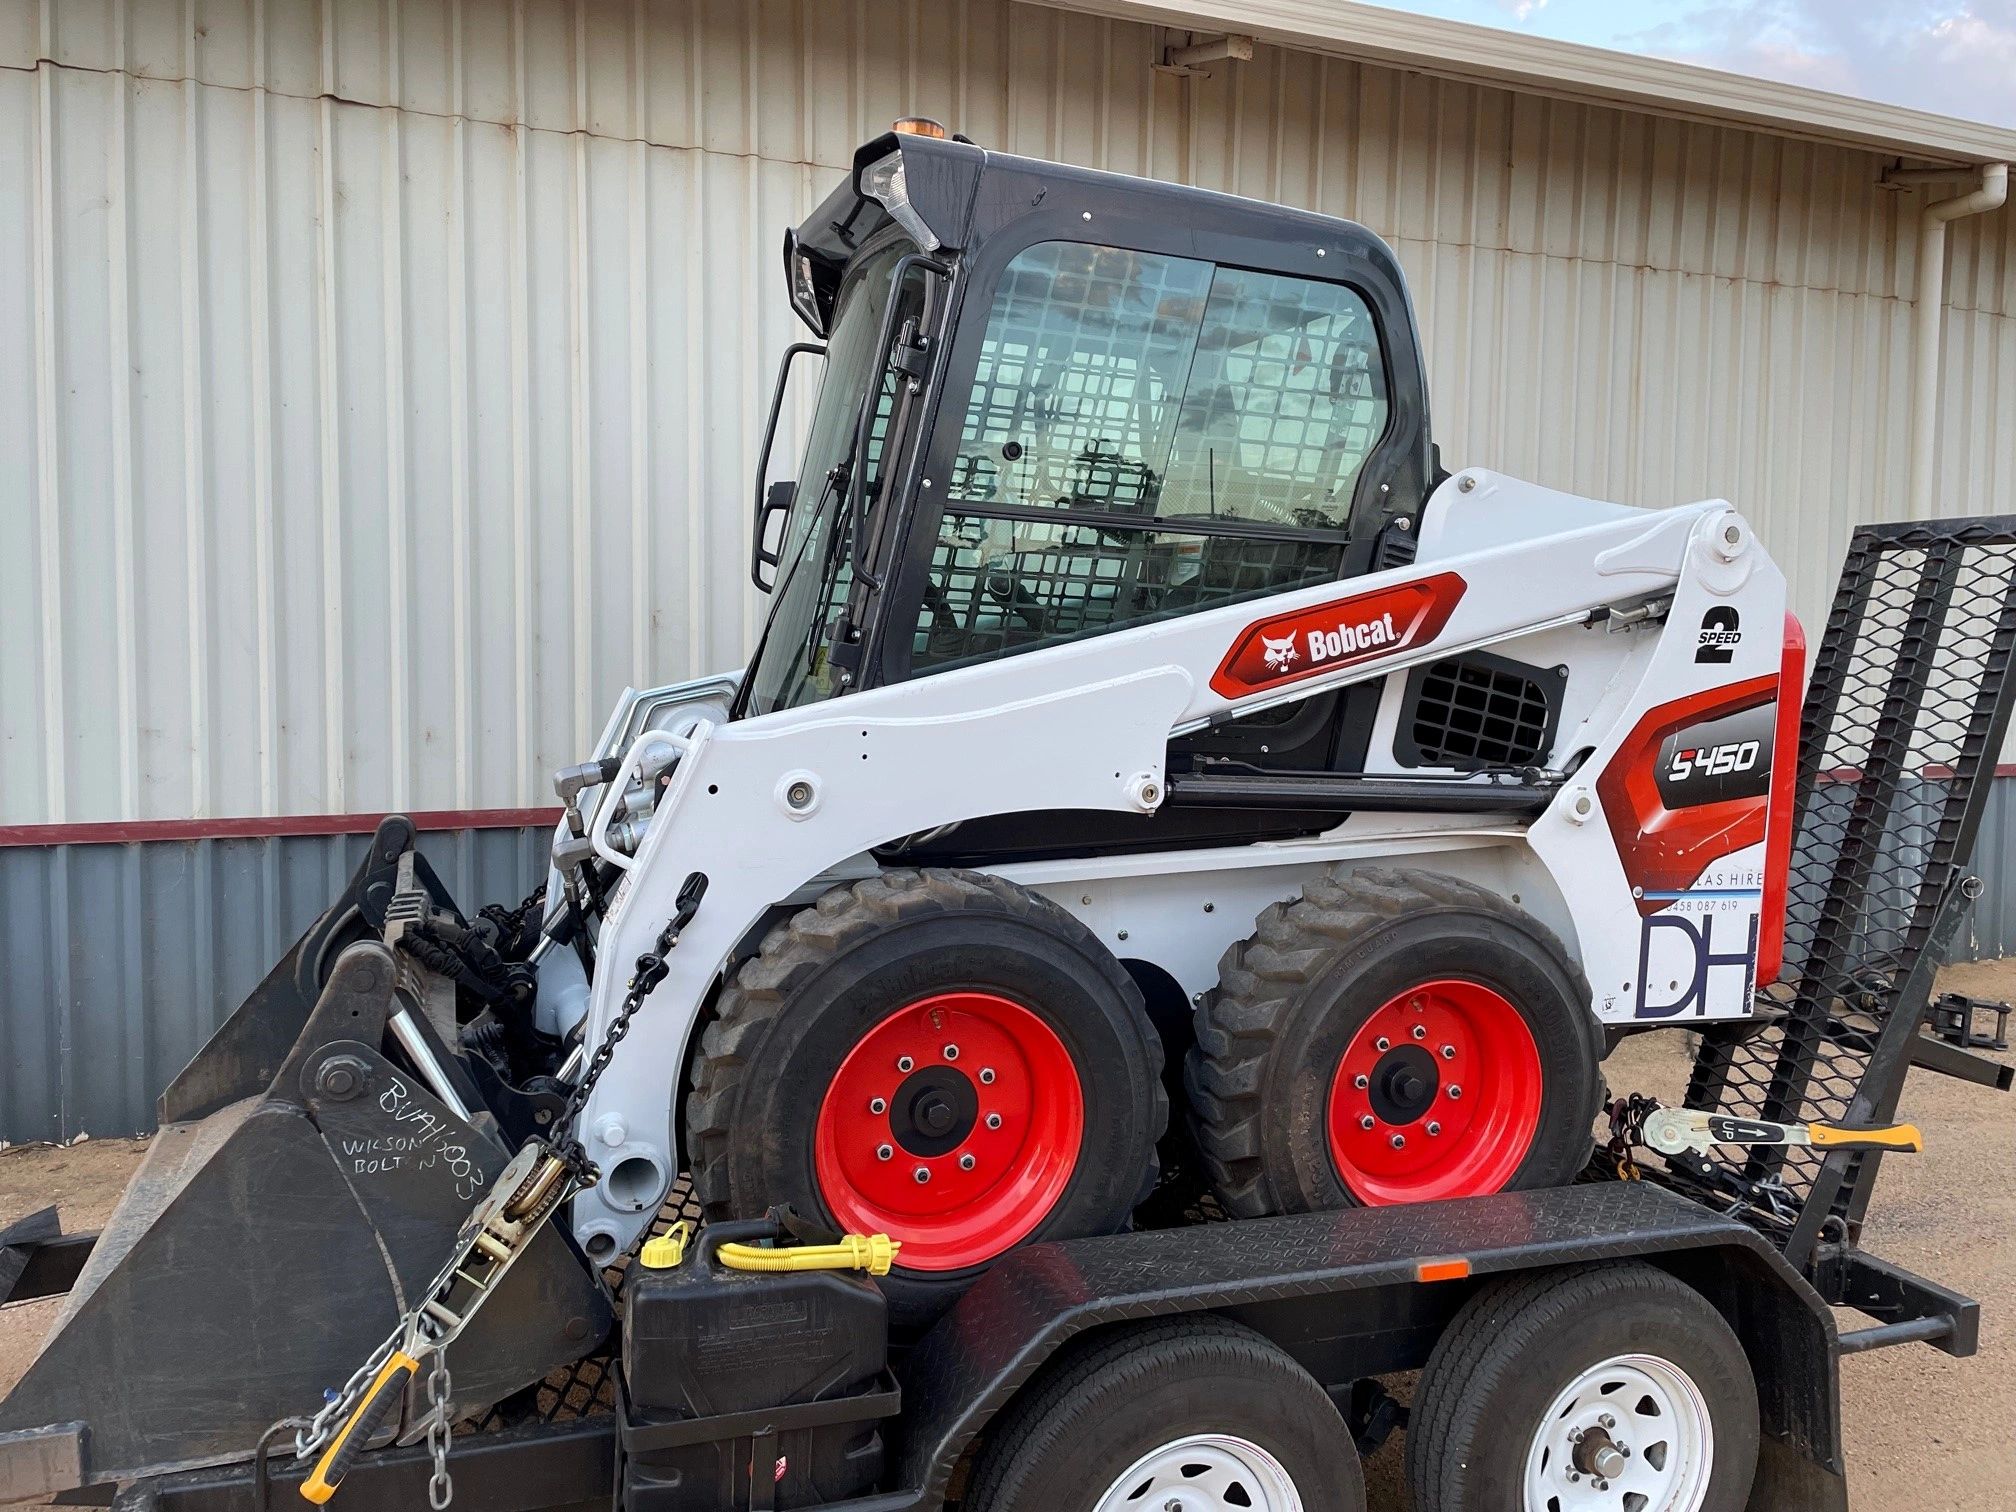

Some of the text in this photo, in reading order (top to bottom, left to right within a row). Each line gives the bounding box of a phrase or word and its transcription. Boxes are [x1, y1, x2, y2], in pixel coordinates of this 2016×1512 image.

[1307, 612, 1396, 662] Bobcat
[1697, 632, 1742, 644] SPEED
[1668, 740, 1761, 782] S450
[1729, 872, 1764, 886] HIRE
[1697, 900, 1717, 911] 087
[1721, 900, 1738, 911] 619
[1635, 913, 1760, 1019] DH
[1721, 1120, 1735, 1140] UP
[342, 1136, 423, 1156] WILSON
